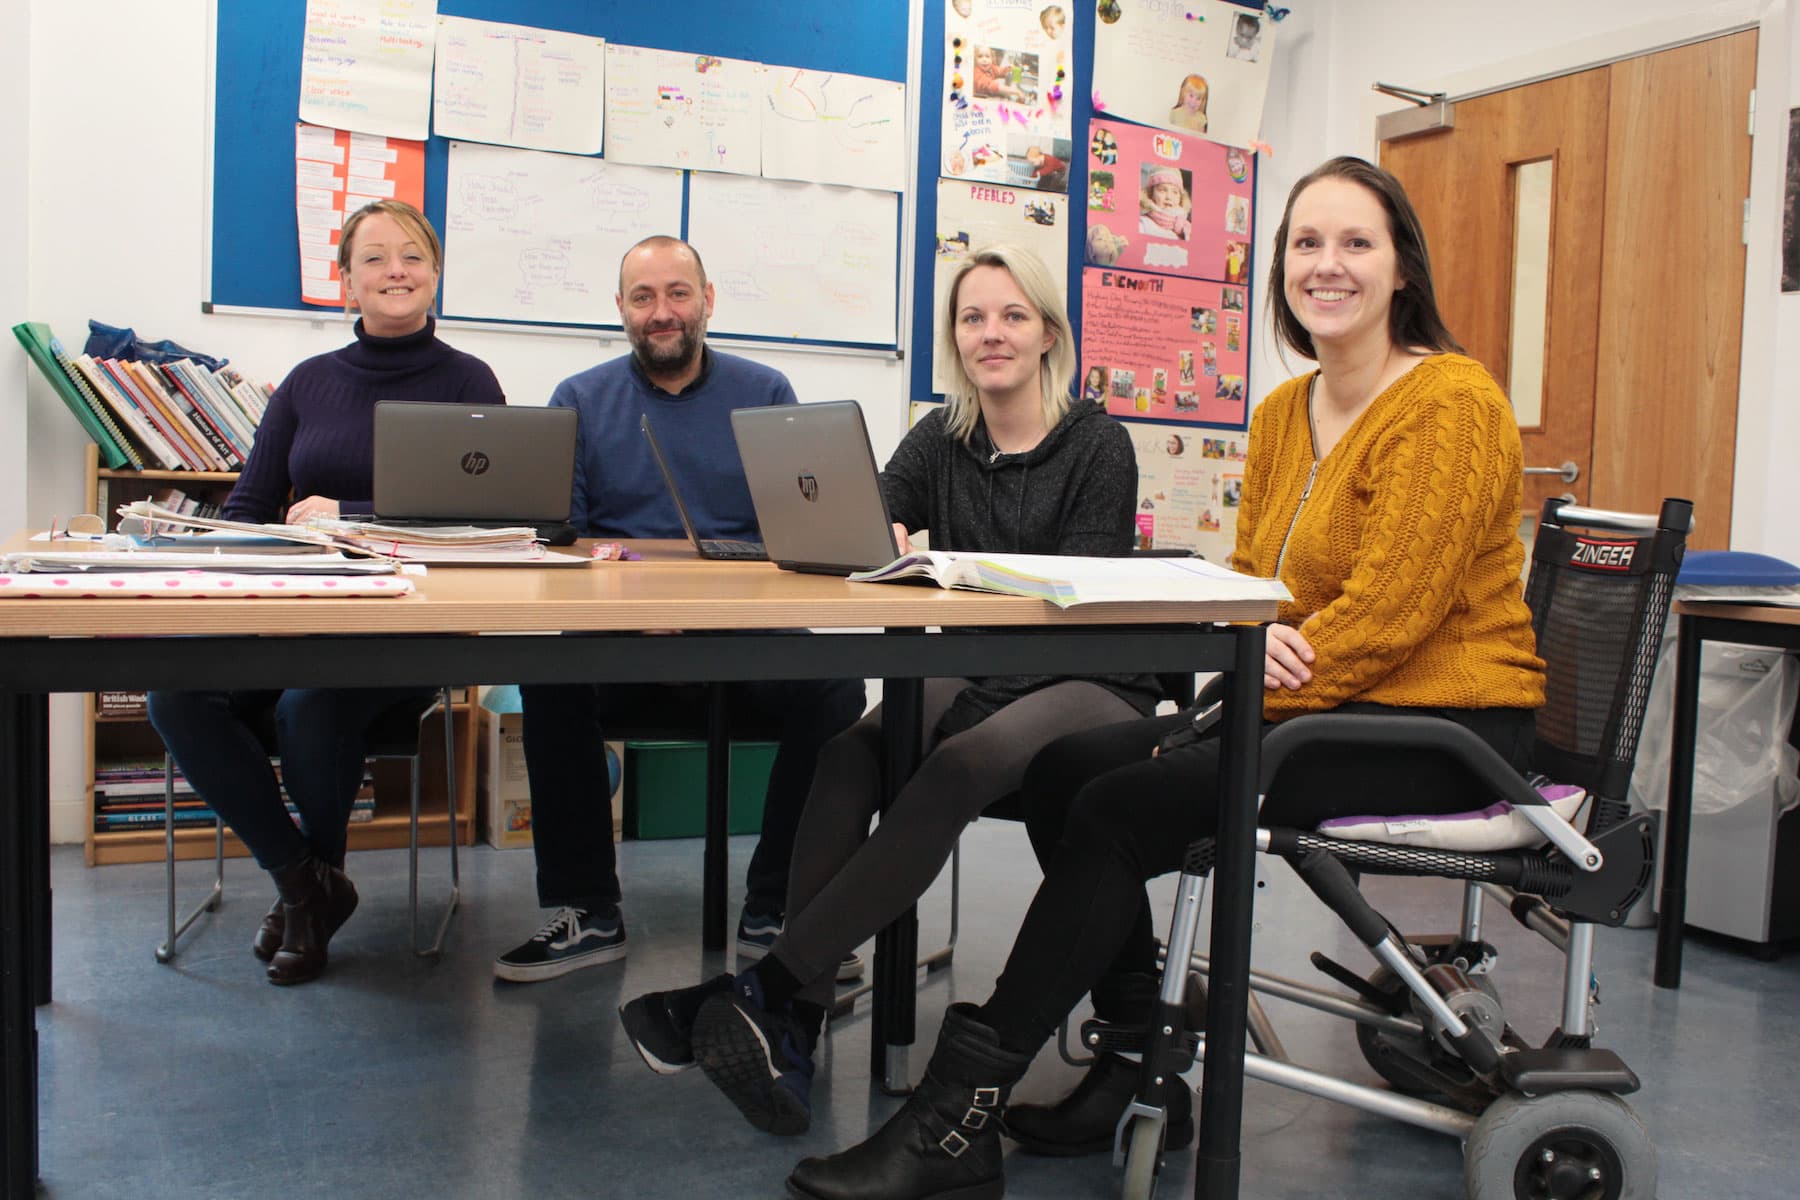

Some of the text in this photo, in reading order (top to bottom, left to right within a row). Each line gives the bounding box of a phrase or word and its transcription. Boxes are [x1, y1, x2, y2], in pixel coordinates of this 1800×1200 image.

[1156, 136, 1180, 157] PLAY
[1101, 272, 1164, 292] EYEMOUTH
[192, 411, 212, 436] History
[217, 442, 230, 456] Art
[464, 451, 488, 476] hp
[1571, 542, 1636, 566] ZINGER
